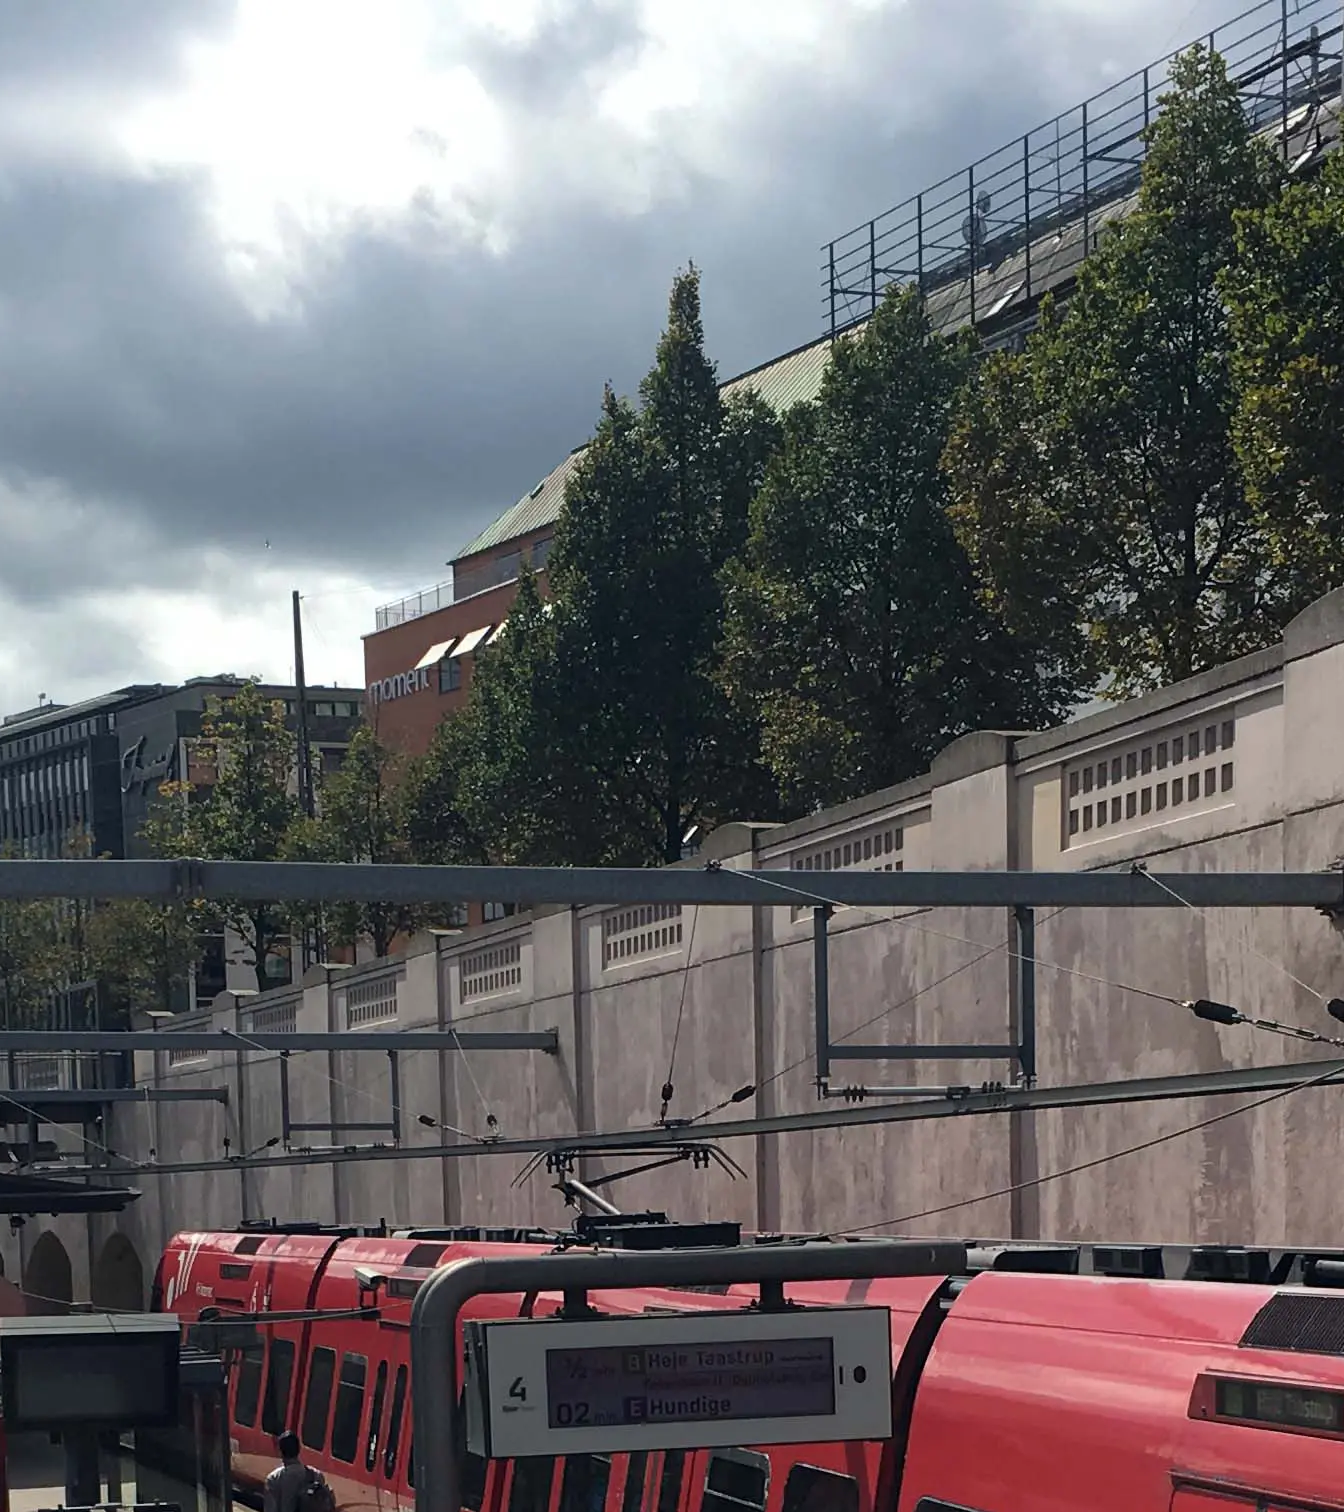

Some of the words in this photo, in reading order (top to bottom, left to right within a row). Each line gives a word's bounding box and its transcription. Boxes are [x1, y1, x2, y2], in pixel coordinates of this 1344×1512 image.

[369, 667, 431, 704] moment
[698, 1347, 774, 1367] Taastrup
[509, 1377, 527, 1401] 4
[556, 1402, 591, 1425] 02
[630, 1401, 642, 1417] E
[650, 1396, 732, 1416] Hundige
